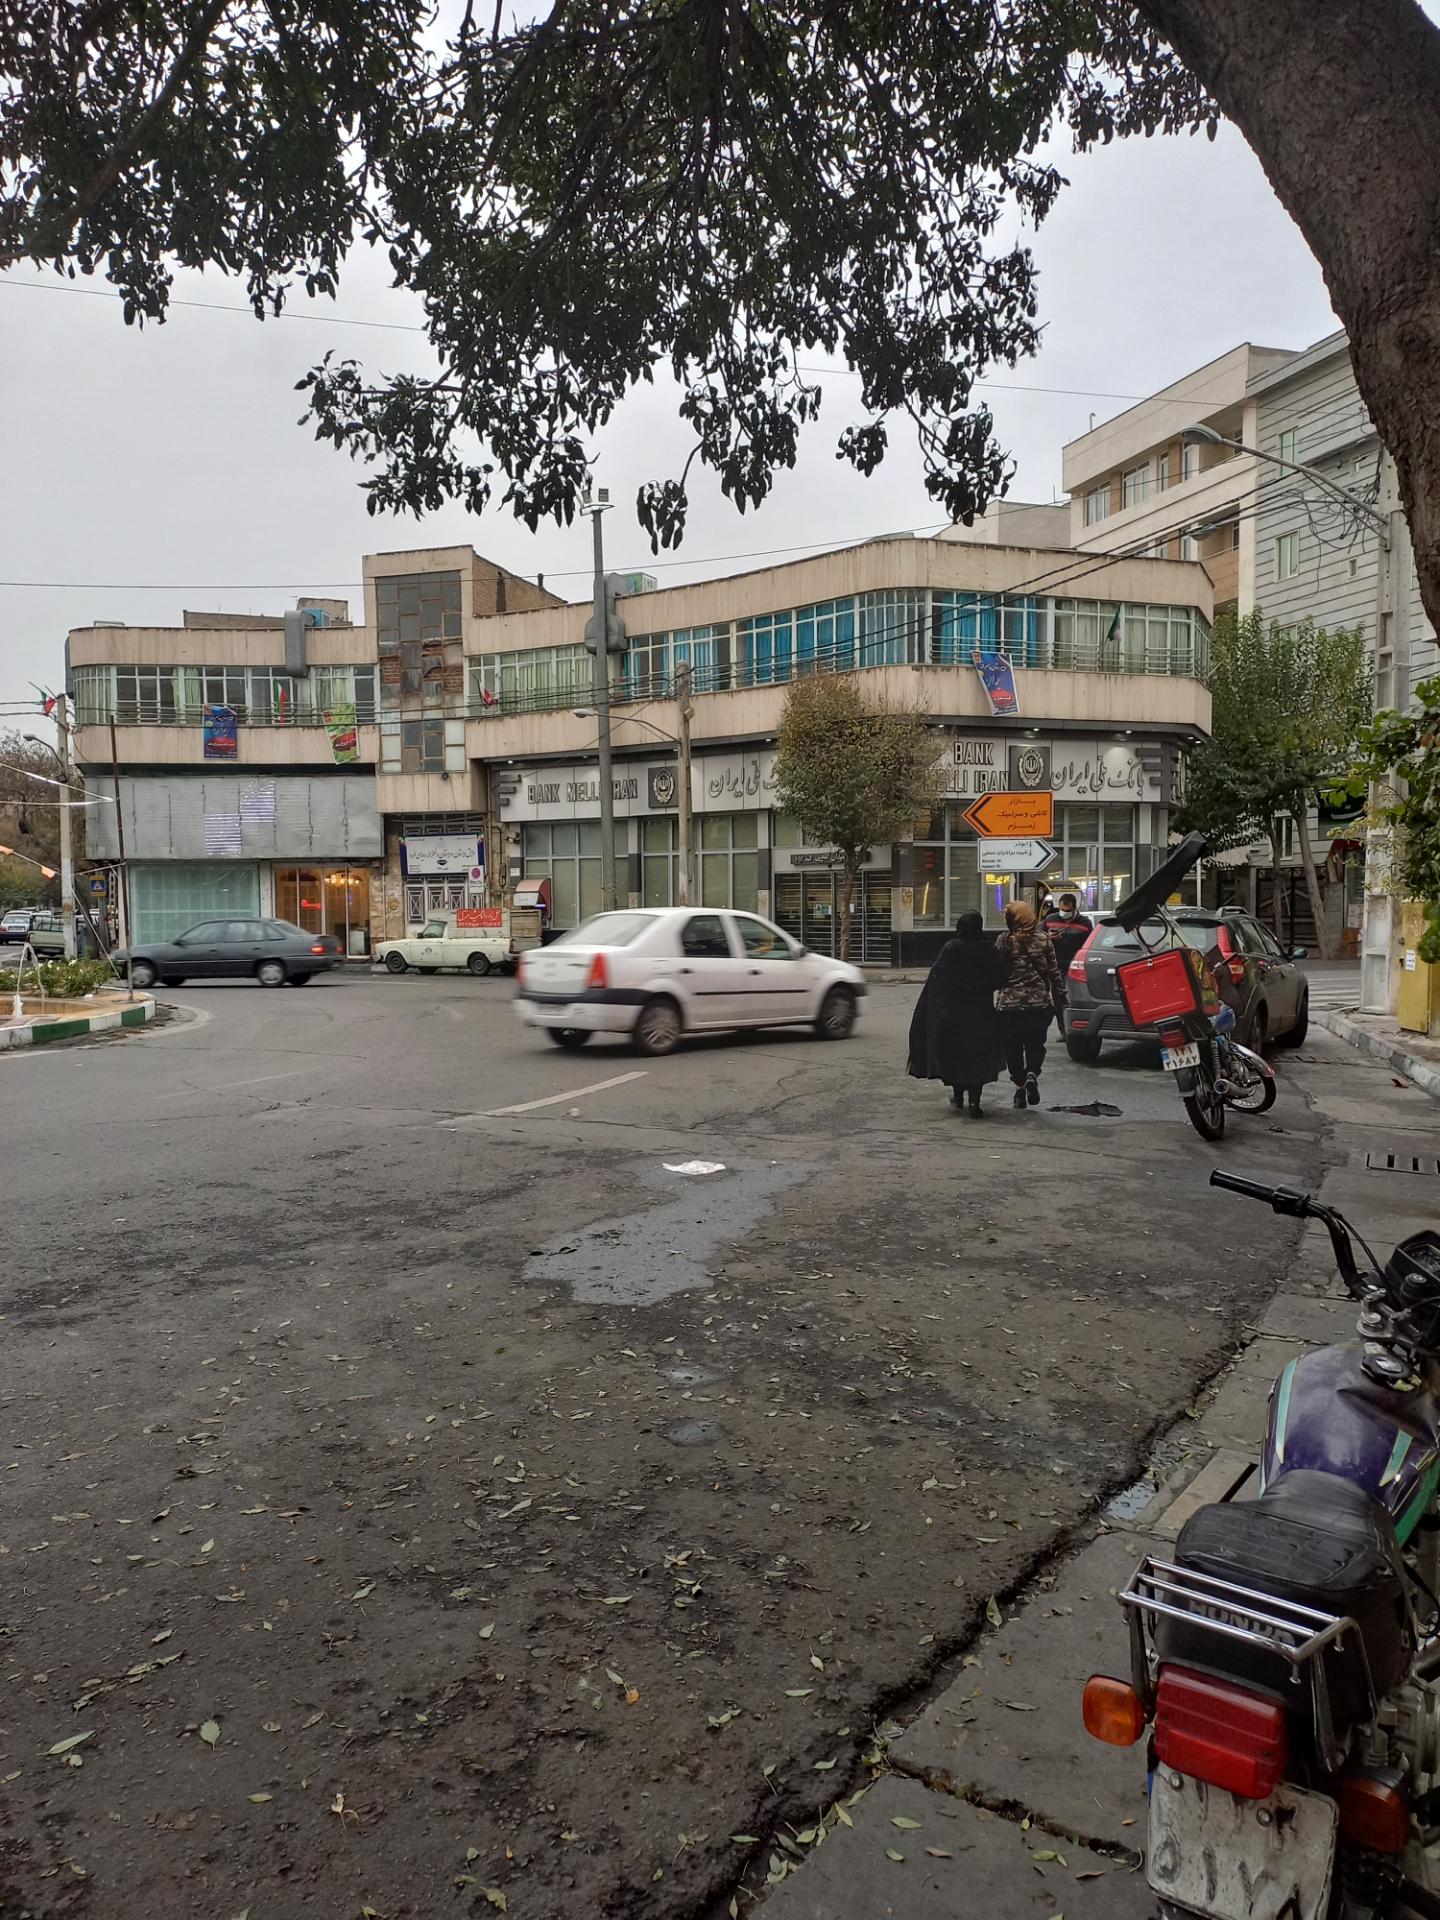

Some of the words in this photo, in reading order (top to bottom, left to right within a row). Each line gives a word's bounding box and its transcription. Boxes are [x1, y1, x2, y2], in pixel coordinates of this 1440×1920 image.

[954, 741, 994, 765] BANK
[527, 783, 560, 804] BANK
[566, 780, 602, 802] MELL
[610, 778, 638, 800] RAN
[709, 767, 745, 798] ایران
[745, 760, 761, 795] ملی
[926, 769, 968, 792] ELLI
[974, 770, 1009, 793] IRAN
[1050, 760, 1090, 794] ایران
[1089, 756, 1106, 792] ملی
[1107, 757, 1145, 795] بانک
[1188, 1599, 1296, 1647] HONDA
